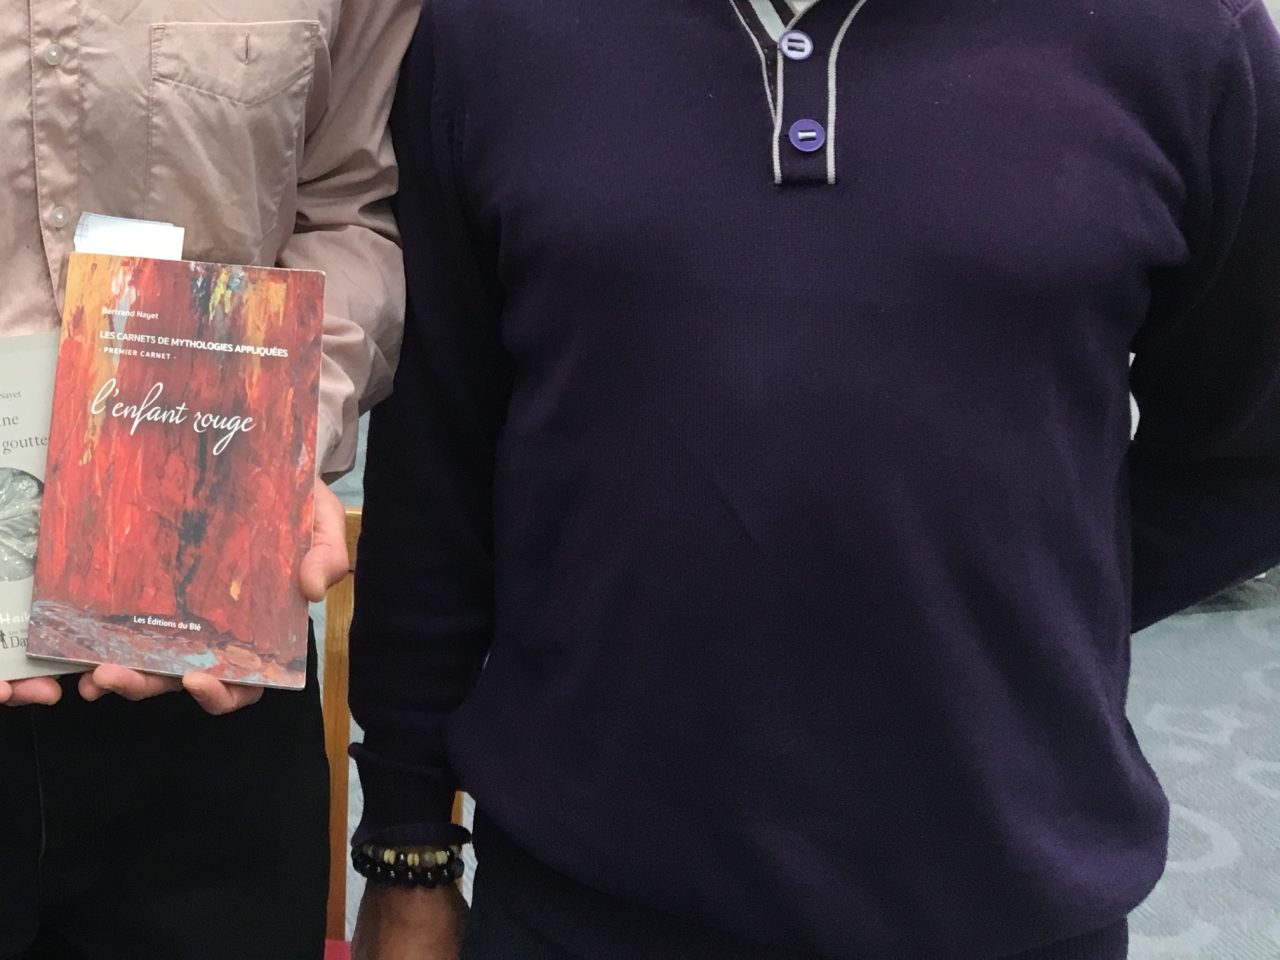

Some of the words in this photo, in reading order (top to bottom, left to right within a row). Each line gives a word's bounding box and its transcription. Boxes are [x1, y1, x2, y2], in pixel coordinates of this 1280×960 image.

[102, 307, 135, 317] Bertrand
[136, 310, 159, 320] Nayet
[99, 330, 115, 340] LES
[116, 332, 156, 344] CARNETS
[157, 336, 170, 345] DE
[170, 338, 233, 352] MYTHOLOGIES
[235, 344, 288, 358] APPLIQUÉES
[103, 346, 138, 356] PREMIER
[140, 350, 171, 360] CARNET
[91, 378, 189, 436] l'enfant
[193, 410, 257, 456] rouge
[133, 615, 146, 624] Les
[147, 615, 177, 628] Éditions
[177, 622, 188, 630] du
[189, 622, 202, 632] Blé
